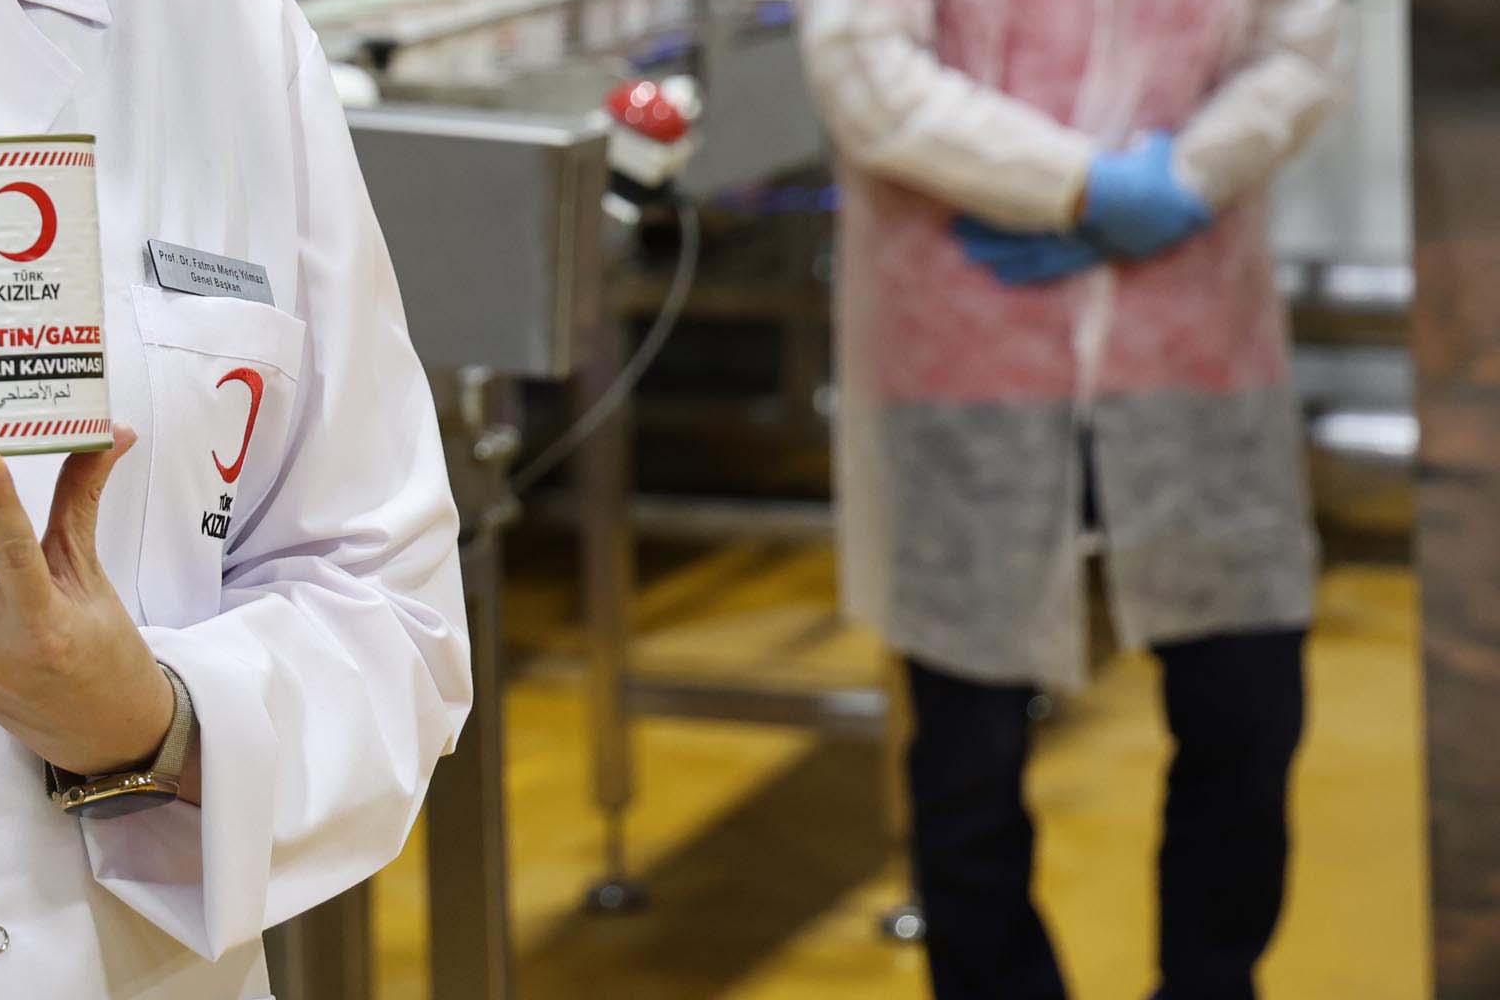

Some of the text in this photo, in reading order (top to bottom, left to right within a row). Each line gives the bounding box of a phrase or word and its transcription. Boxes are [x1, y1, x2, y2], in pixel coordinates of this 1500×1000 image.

[12, 269, 44, 281] TÜRK
[158, 250, 178, 263] Prof.
[180, 256, 192, 268] Dr.
[193, 258, 216, 272] Fatma
[217, 263, 239, 279] Meriç
[190, 271, 241, 292] Genel Başkan
